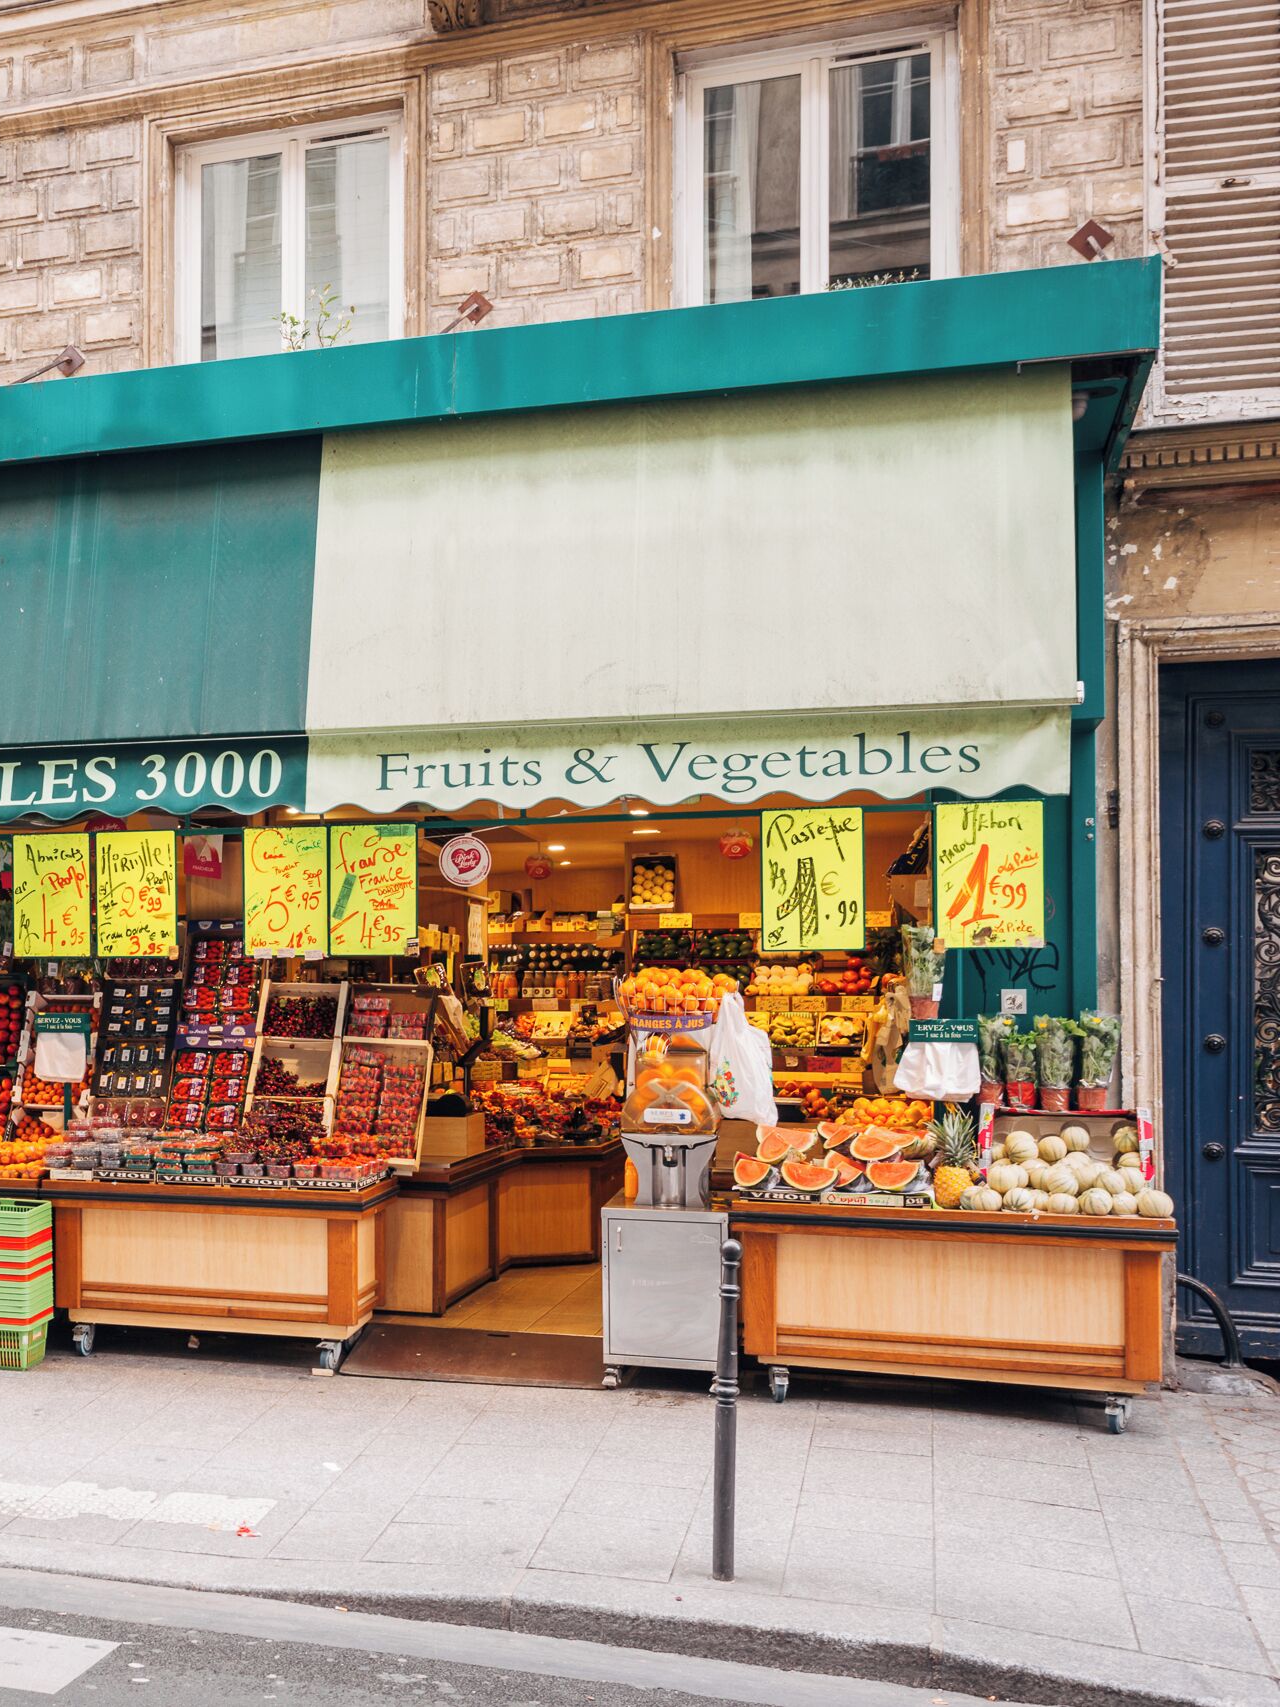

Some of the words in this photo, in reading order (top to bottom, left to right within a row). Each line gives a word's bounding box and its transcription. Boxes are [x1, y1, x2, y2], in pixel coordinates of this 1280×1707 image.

[135, 749, 284, 801] 3000
[375, 747, 543, 792] Fruits
[563, 748, 619, 785] &
[636, 731, 982, 794] Vegetables
[675, 1017, 682, 1029] À
[685, 1018, 705, 1028] JUS
[916, 1024, 945, 1032] ERVEZ
